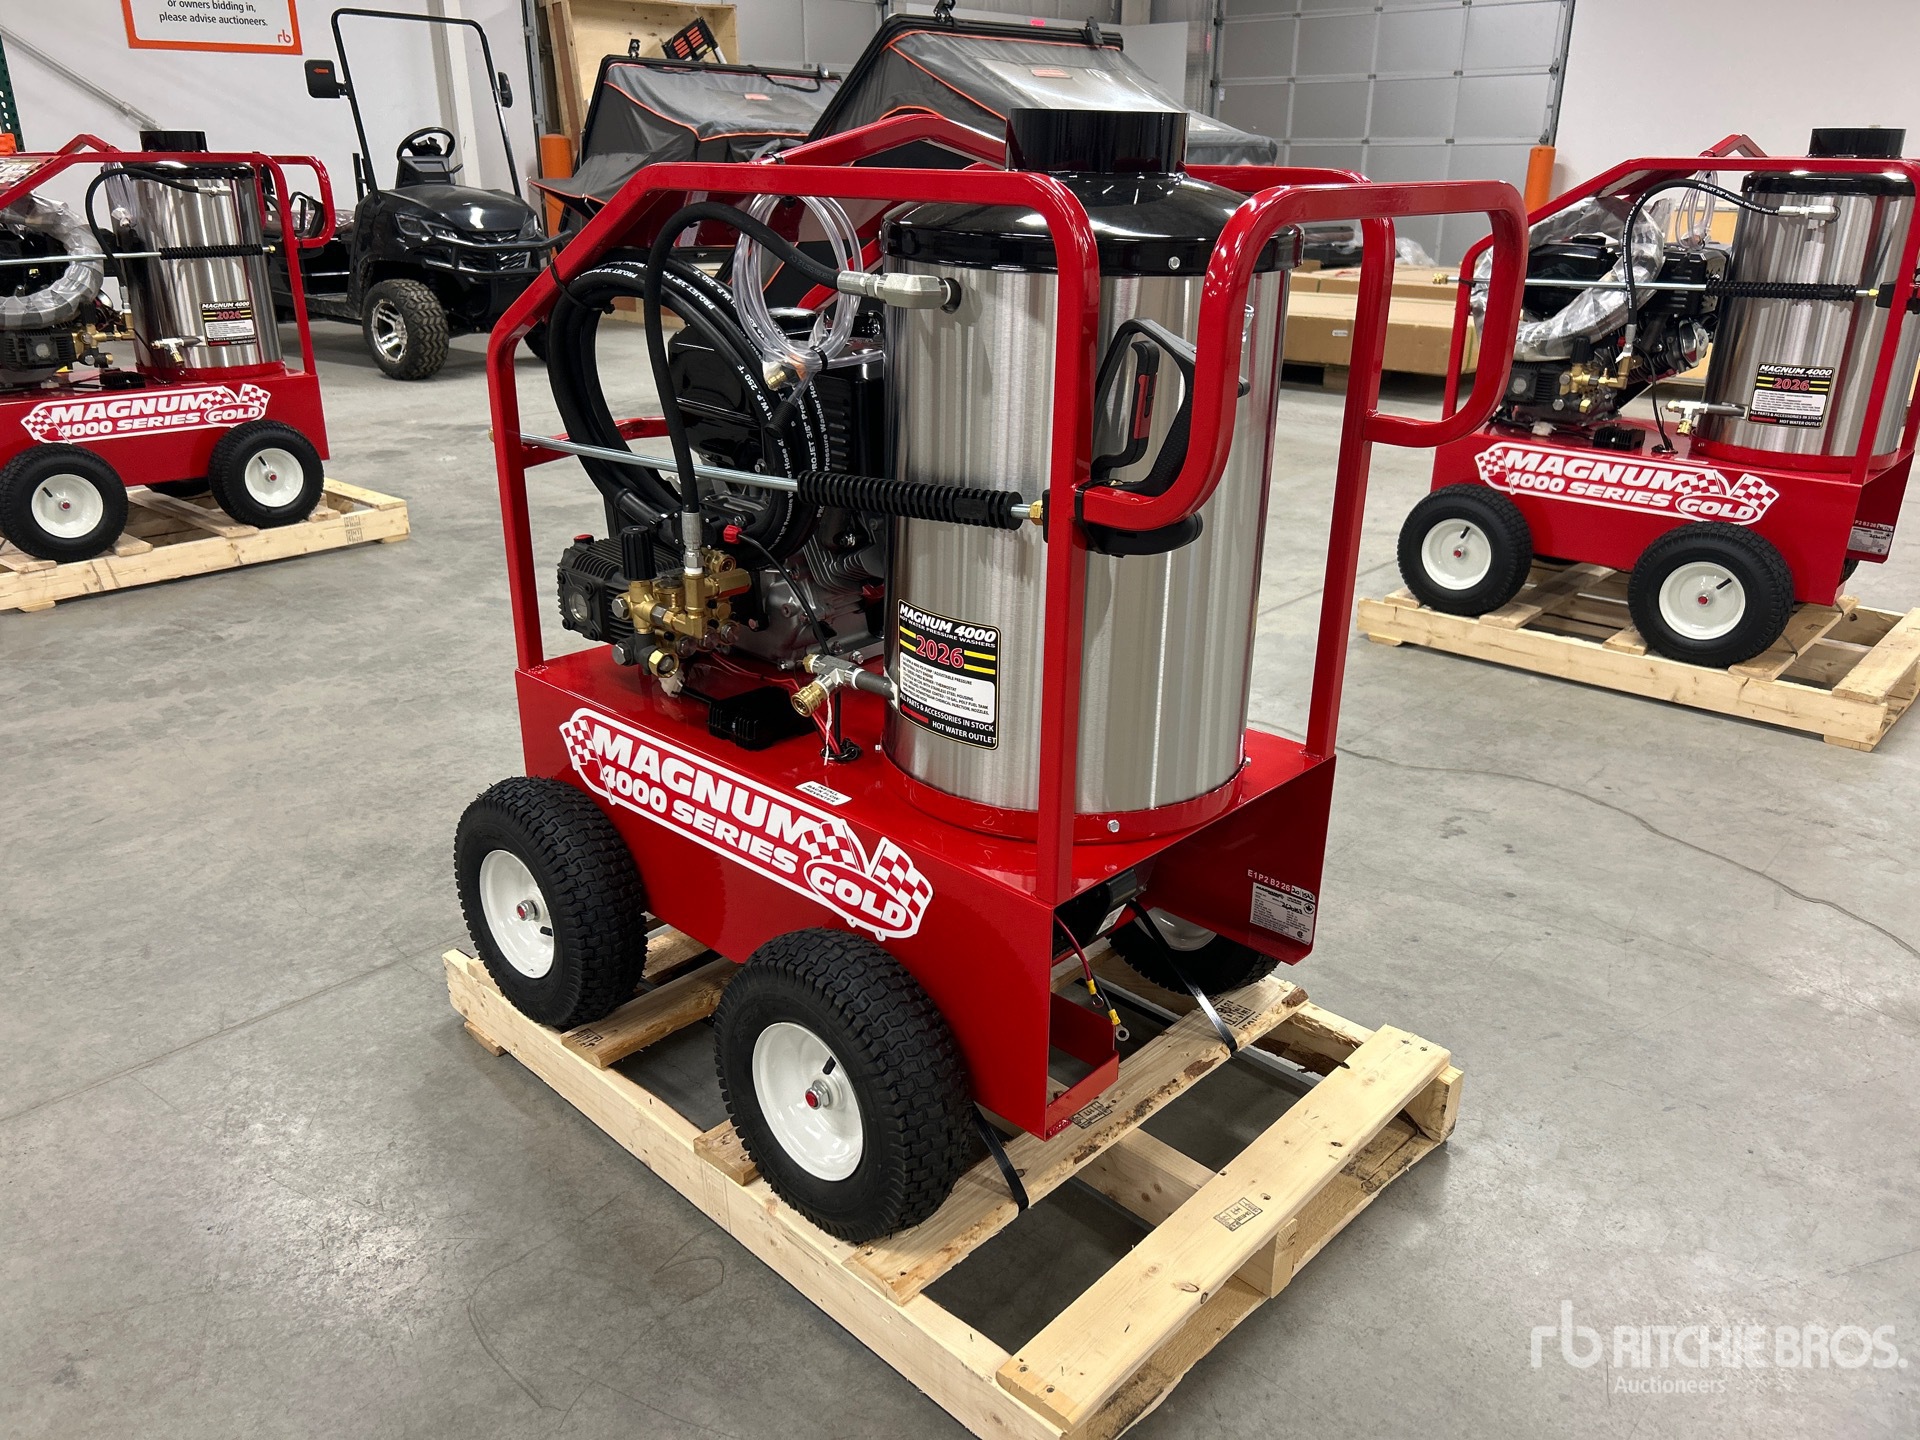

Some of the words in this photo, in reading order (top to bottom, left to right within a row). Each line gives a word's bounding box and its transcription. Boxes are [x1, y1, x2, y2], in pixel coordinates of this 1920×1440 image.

[179, 0, 211, 10] owners
[212, 0, 245, 13] bidding
[246, 2, 257, 13] in,
[159, 11, 188, 24] please
[189, 13, 217, 24] advise
[218, 15, 269, 27] auctioneers.
[277, 29, 292, 44] rb
[686, 284, 716, 310] PROJET
[216, 311, 241, 320] 2026
[744, 373, 756, 391] 250
[1759, 364, 1806, 375] MAGNUM
[1806, 367, 1833, 377] 4000
[1772, 377, 1810, 392] 2026
[52, 392, 212, 424] MAGNUM
[756, 390, 770, 412] W.P.
[116, 412, 201, 431] SERIES
[207, 408, 260, 423] GOLD
[814, 401, 827, 433] Washer
[58, 421, 113, 437] 4000
[782, 447, 793, 470] Hose
[823, 433, 831, 472] Pressure
[1505, 450, 1691, 493] MAGNUM
[1506, 471, 1566, 493] 4000
[1567, 481, 1673, 507] SERIES
[1680, 499, 1756, 520] GOLD
[900, 603, 953, 634] MAGNUM
[954, 625, 997, 643] 4000
[908, 619, 926, 631] WATER
[926, 625, 958, 641] PRESSURE
[959, 636, 996, 648] WASHERS
[915, 634, 965, 669] 2026
[906, 697, 920, 709] PARTS
[920, 703, 924, 711] &
[924, 706, 962, 725] ACCESSORIES
[962, 719, 970, 728] IN
[970, 722, 994, 733] STOCK
[932, 720, 945, 731] HOT
[945, 725, 968, 738] WATER
[968, 732, 997, 744] OUTLET
[590, 722, 819, 846] MAGNUM
[600, 764, 668, 814] 4000
[671, 797, 799, 874] SERIES
[809, 866, 907, 928] GOLD
